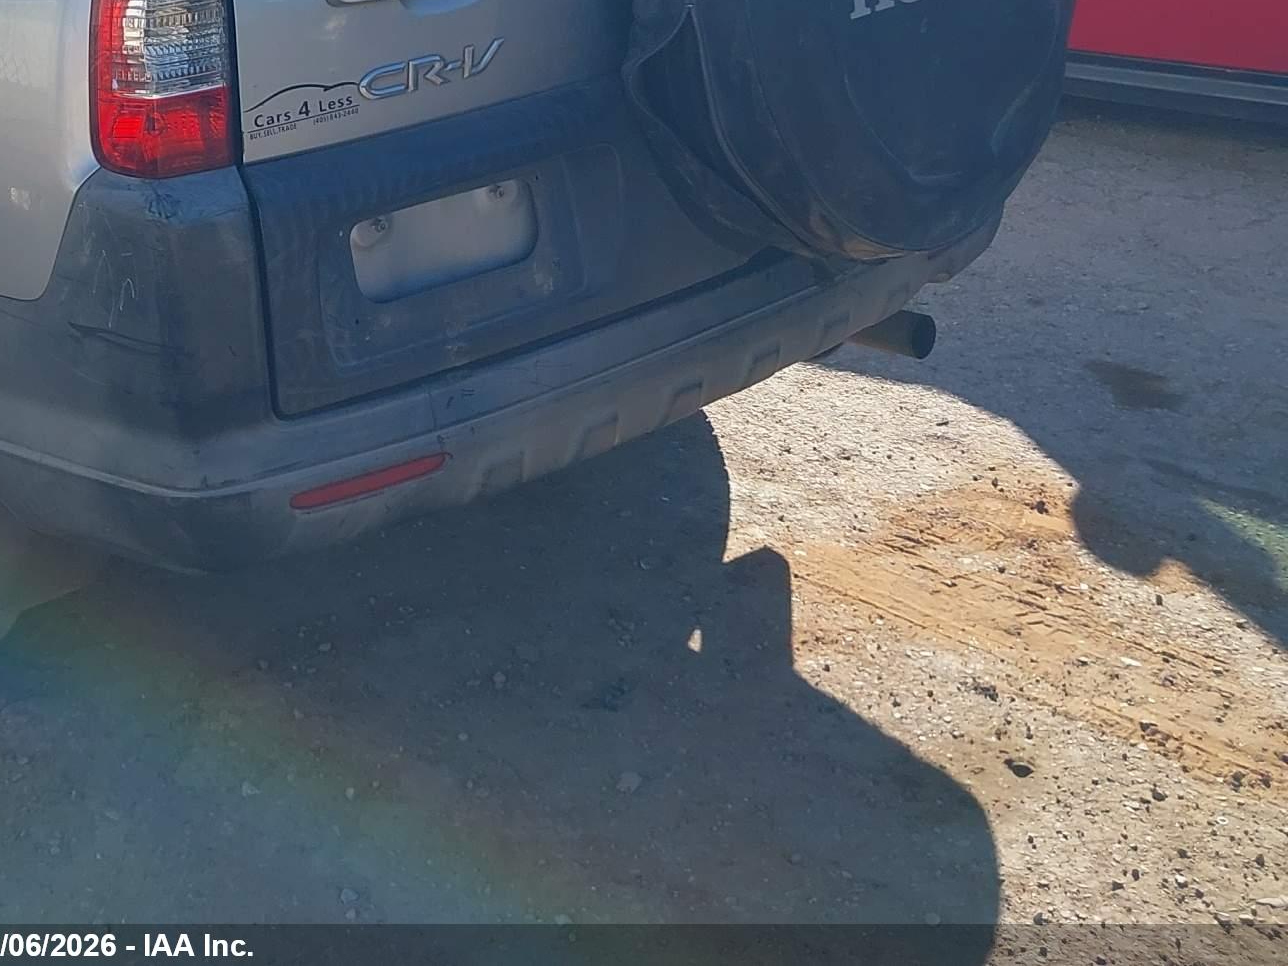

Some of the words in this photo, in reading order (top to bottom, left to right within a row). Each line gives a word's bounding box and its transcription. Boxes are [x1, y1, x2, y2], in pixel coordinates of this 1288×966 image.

[358, 36, 505, 100] CR-V
[254, 111, 292, 128] Cars
[298, 101, 311, 117] 4
[318, 96, 353, 113] Less
